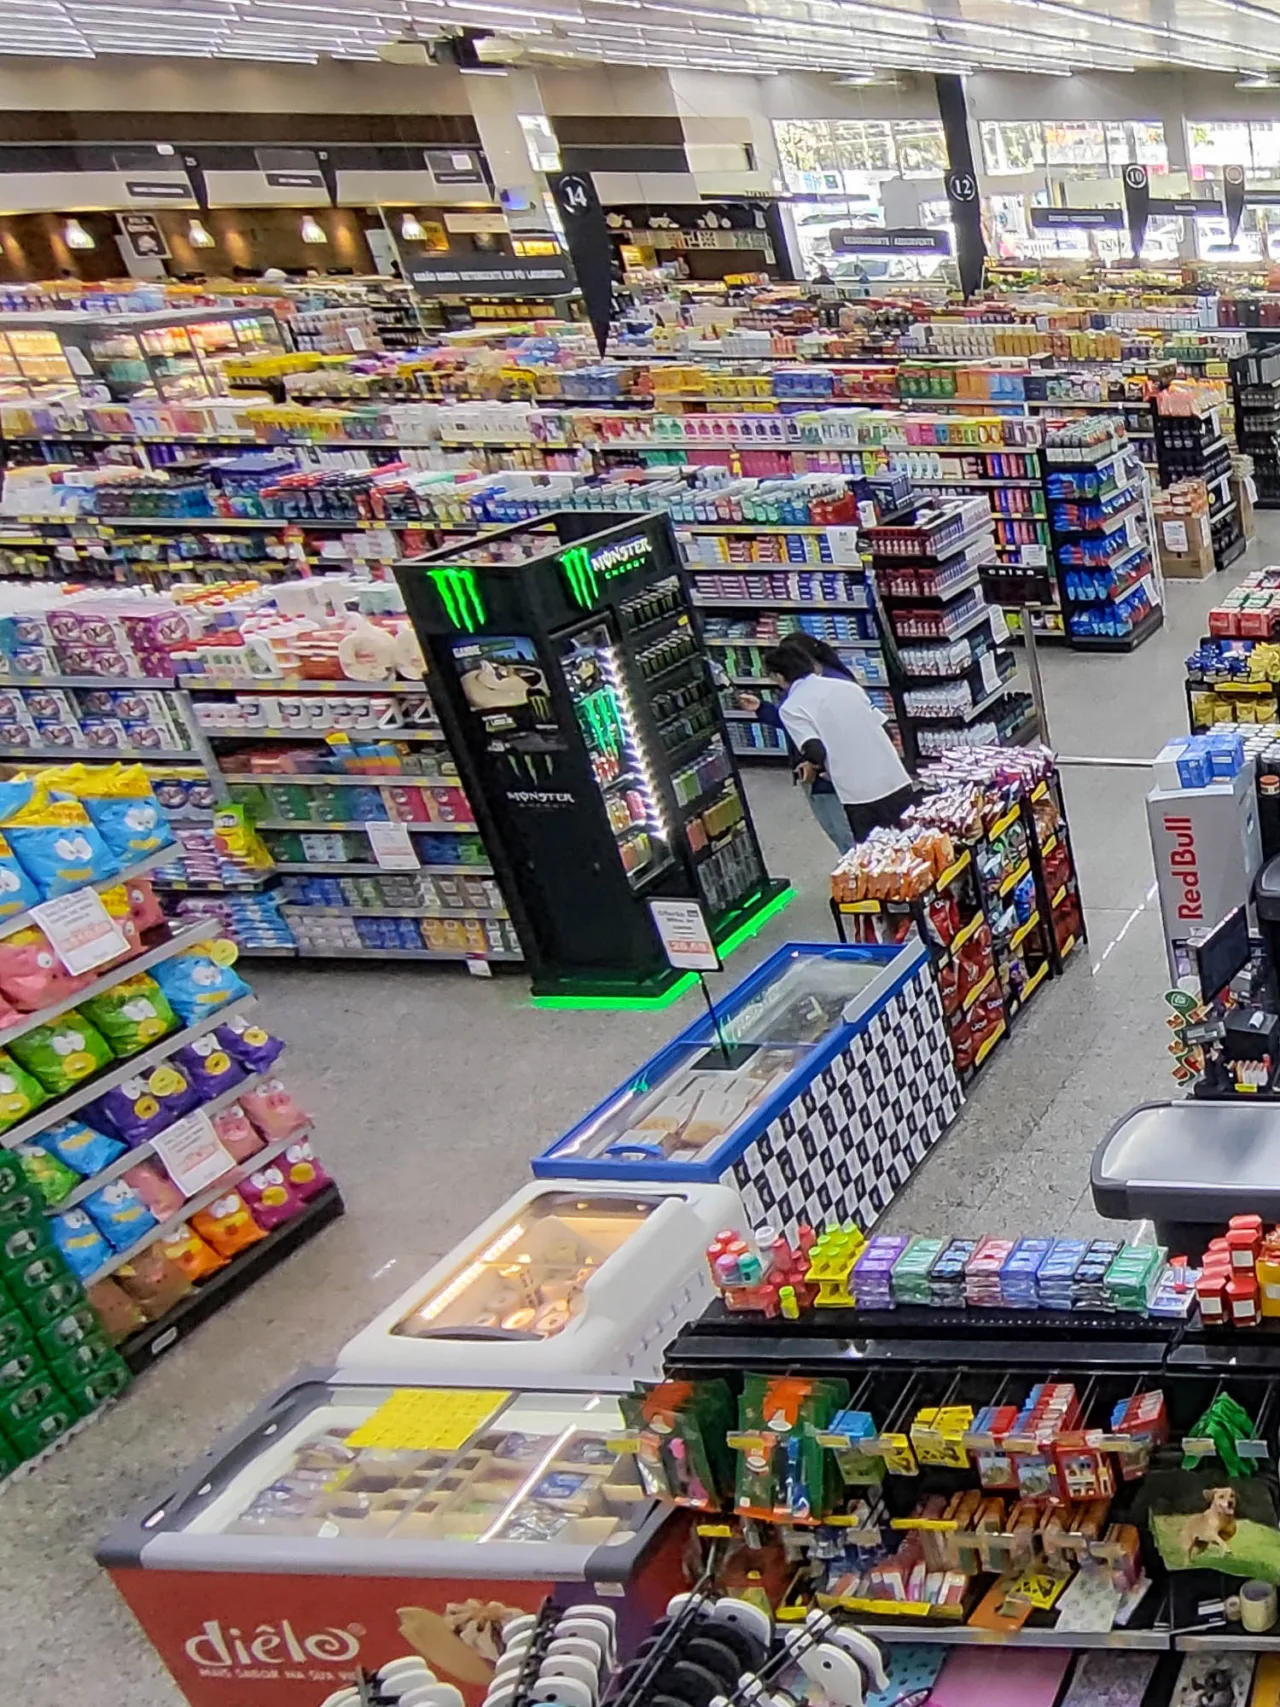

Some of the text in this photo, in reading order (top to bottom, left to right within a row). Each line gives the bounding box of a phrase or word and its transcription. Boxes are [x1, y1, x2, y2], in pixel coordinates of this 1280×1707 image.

[565, 185, 589, 208] 14
[954, 178, 973, 195] 12
[590, 536, 653, 572] MONSTER
[506, 790, 575, 804] MONSTER
[1164, 818, 1204, 920] Red Bull
[185, 1619, 360, 1667] diêlo
